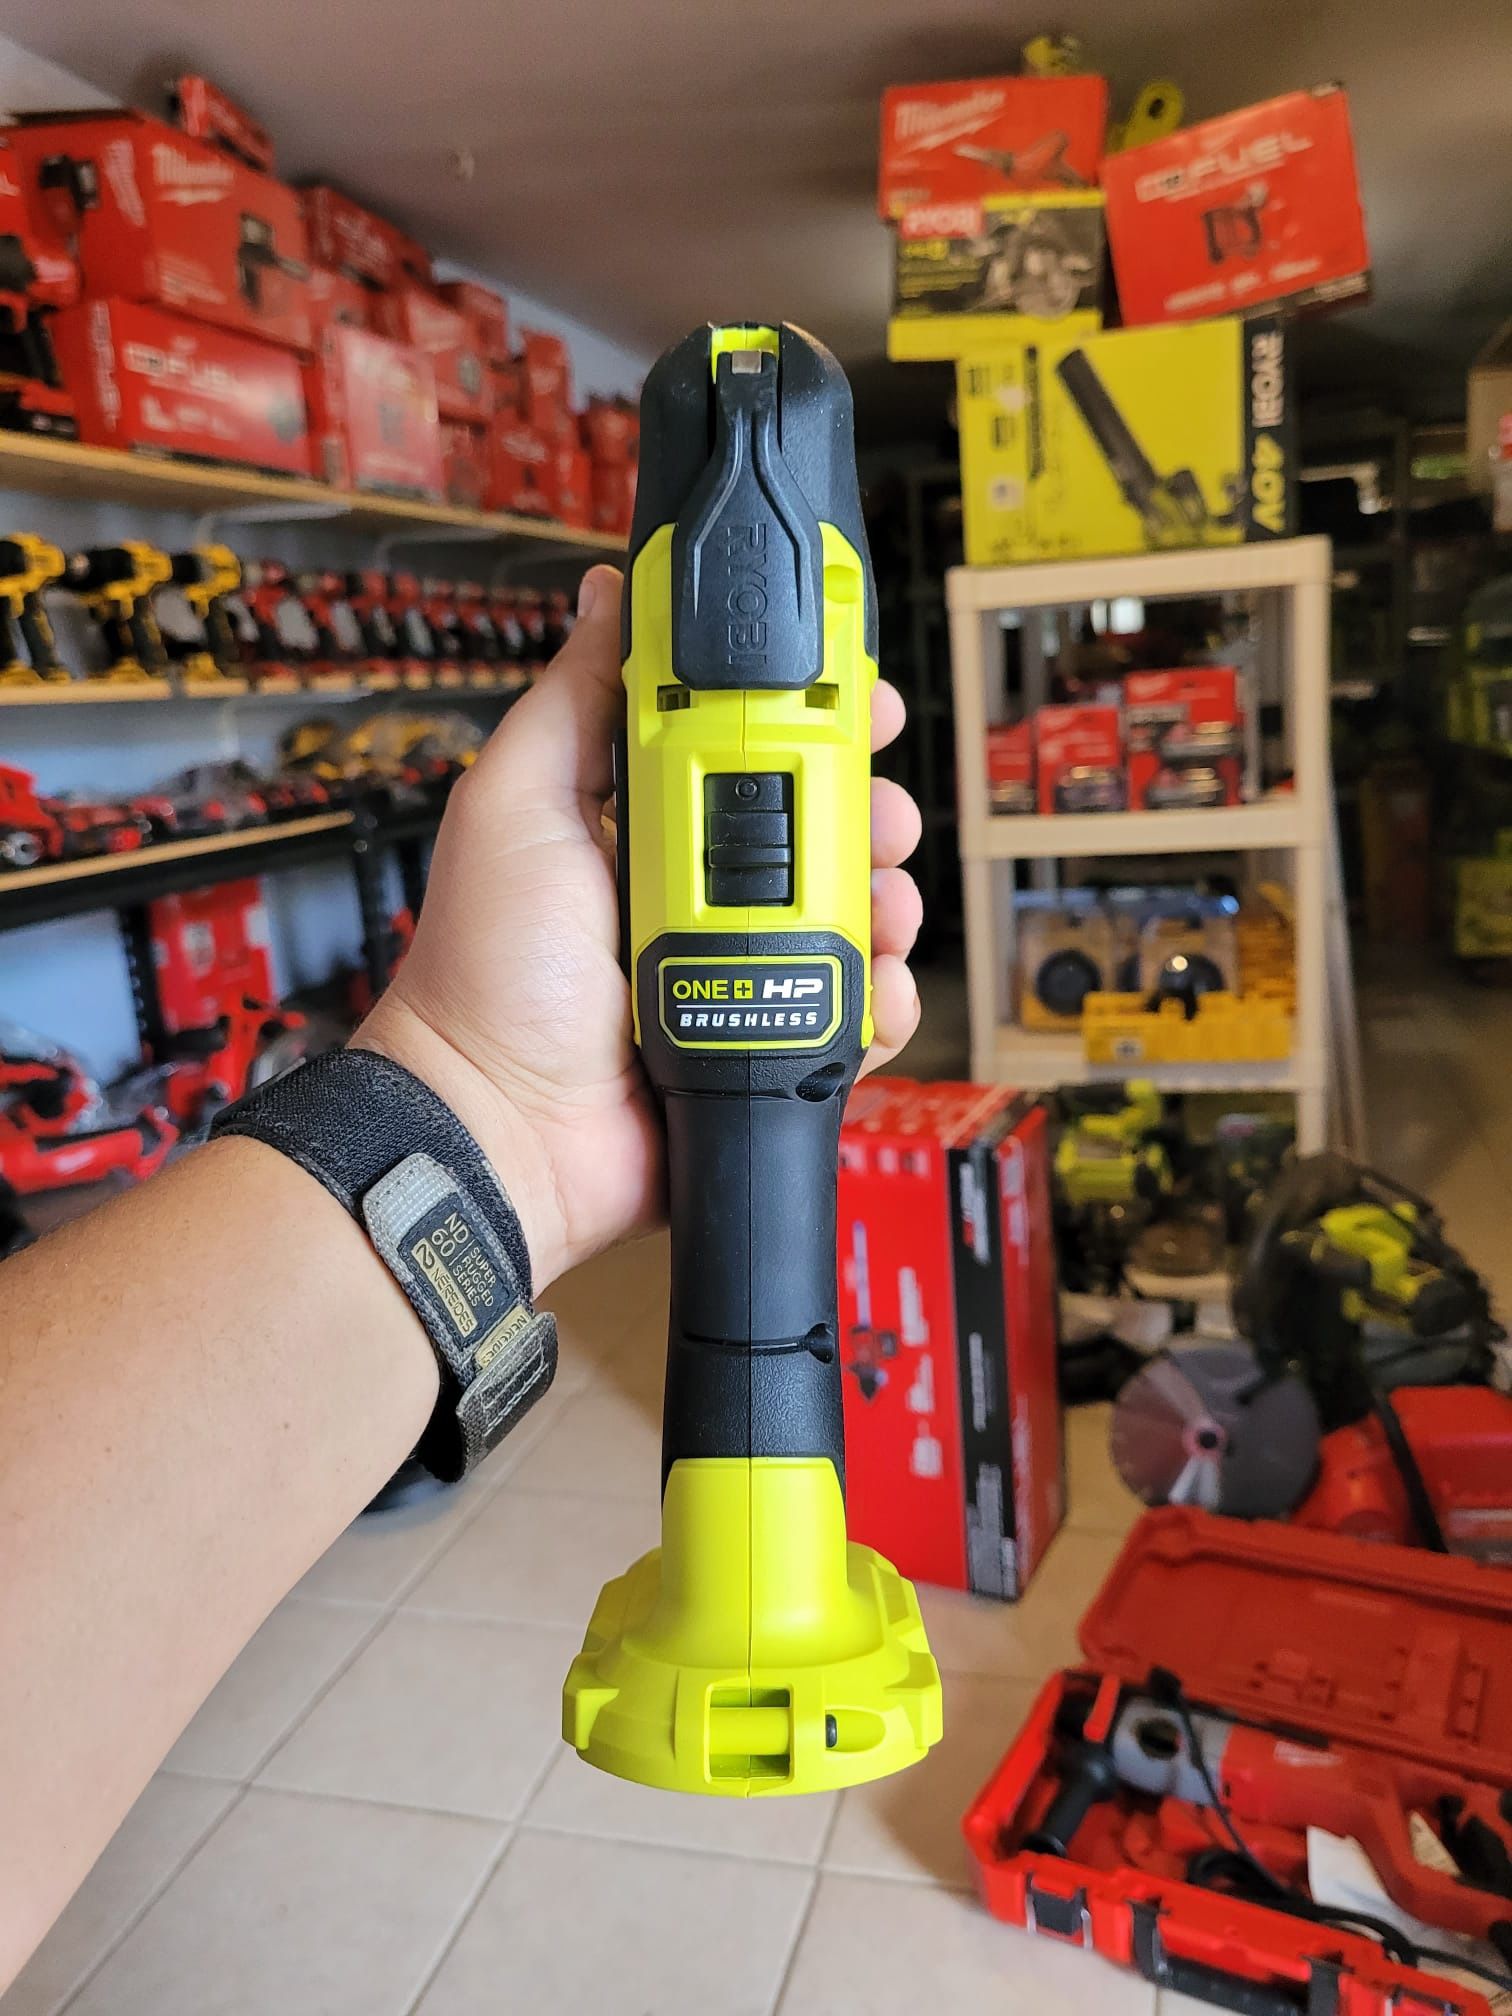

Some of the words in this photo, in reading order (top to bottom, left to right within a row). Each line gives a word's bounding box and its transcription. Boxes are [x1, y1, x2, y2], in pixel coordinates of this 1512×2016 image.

[1251, 332, 1285, 427] RYOBI
[1252, 432, 1286, 533] 40V
[727, 522, 768, 666] RYOBI
[762, 978, 823, 999] HP
[679, 1011, 818, 1028] BRUSHLESS
[431, 1228, 456, 1257] 60
[444, 1212, 469, 1243] ND
[452, 1265, 480, 1307] SERIES
[462, 1256, 494, 1307] RUGGED
[470, 1247, 496, 1288] SUPER
